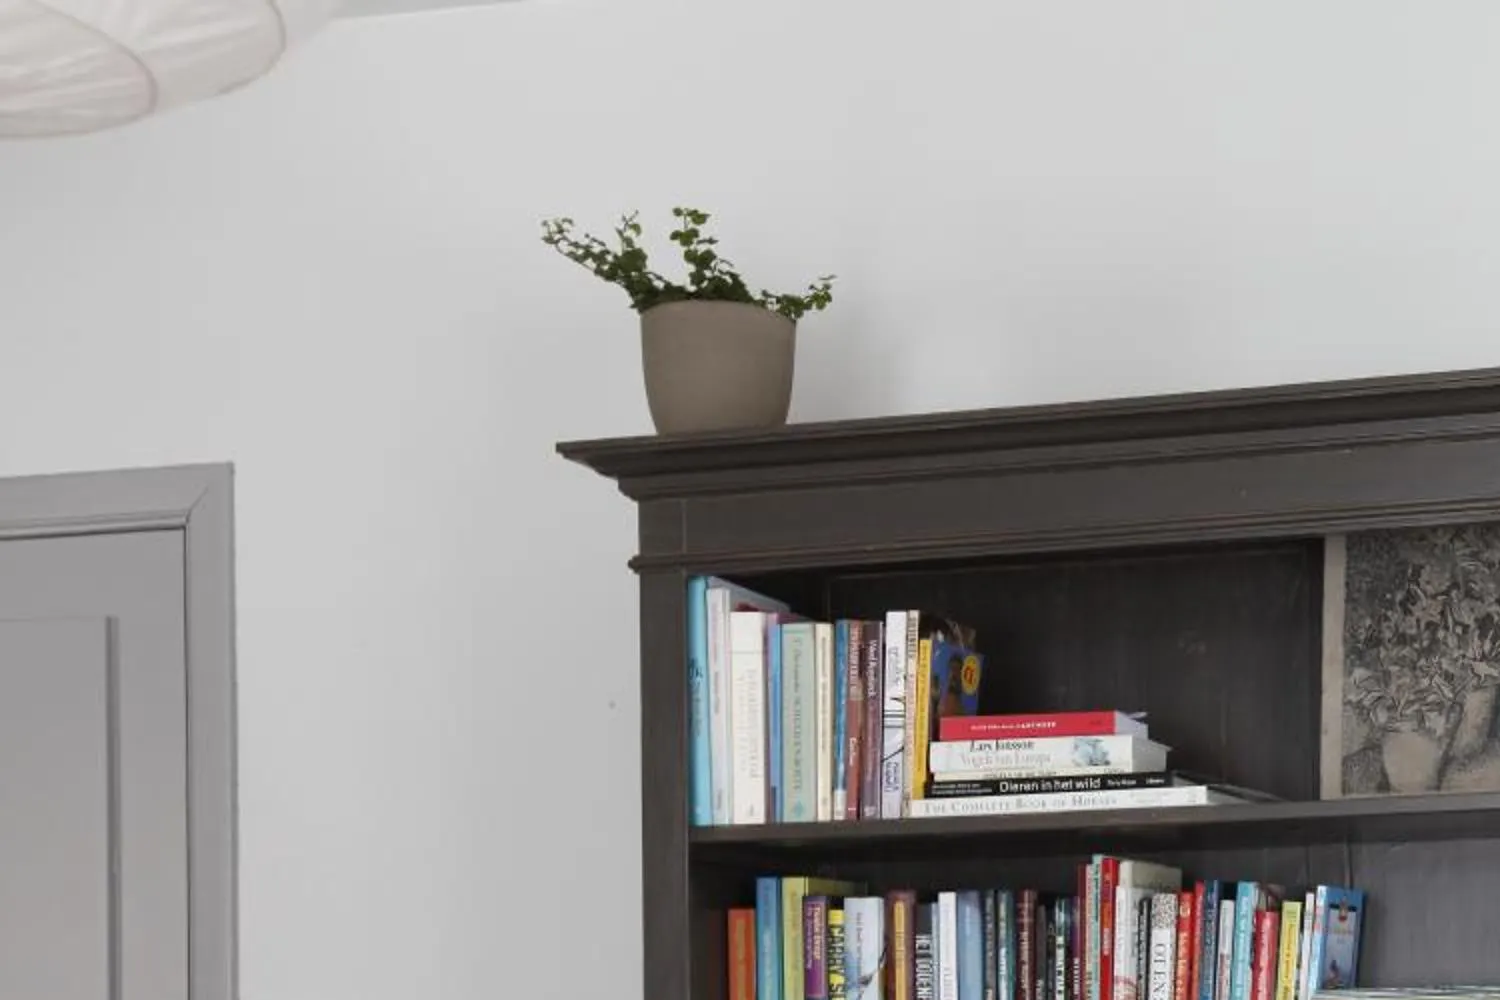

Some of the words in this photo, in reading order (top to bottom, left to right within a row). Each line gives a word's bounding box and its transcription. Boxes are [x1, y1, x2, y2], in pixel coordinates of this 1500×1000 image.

[999, 780, 1040, 793] Dieren
[1041, 779, 1053, 791] in
[1053, 778, 1073, 791] het
[1075, 777, 1101, 790] wild
